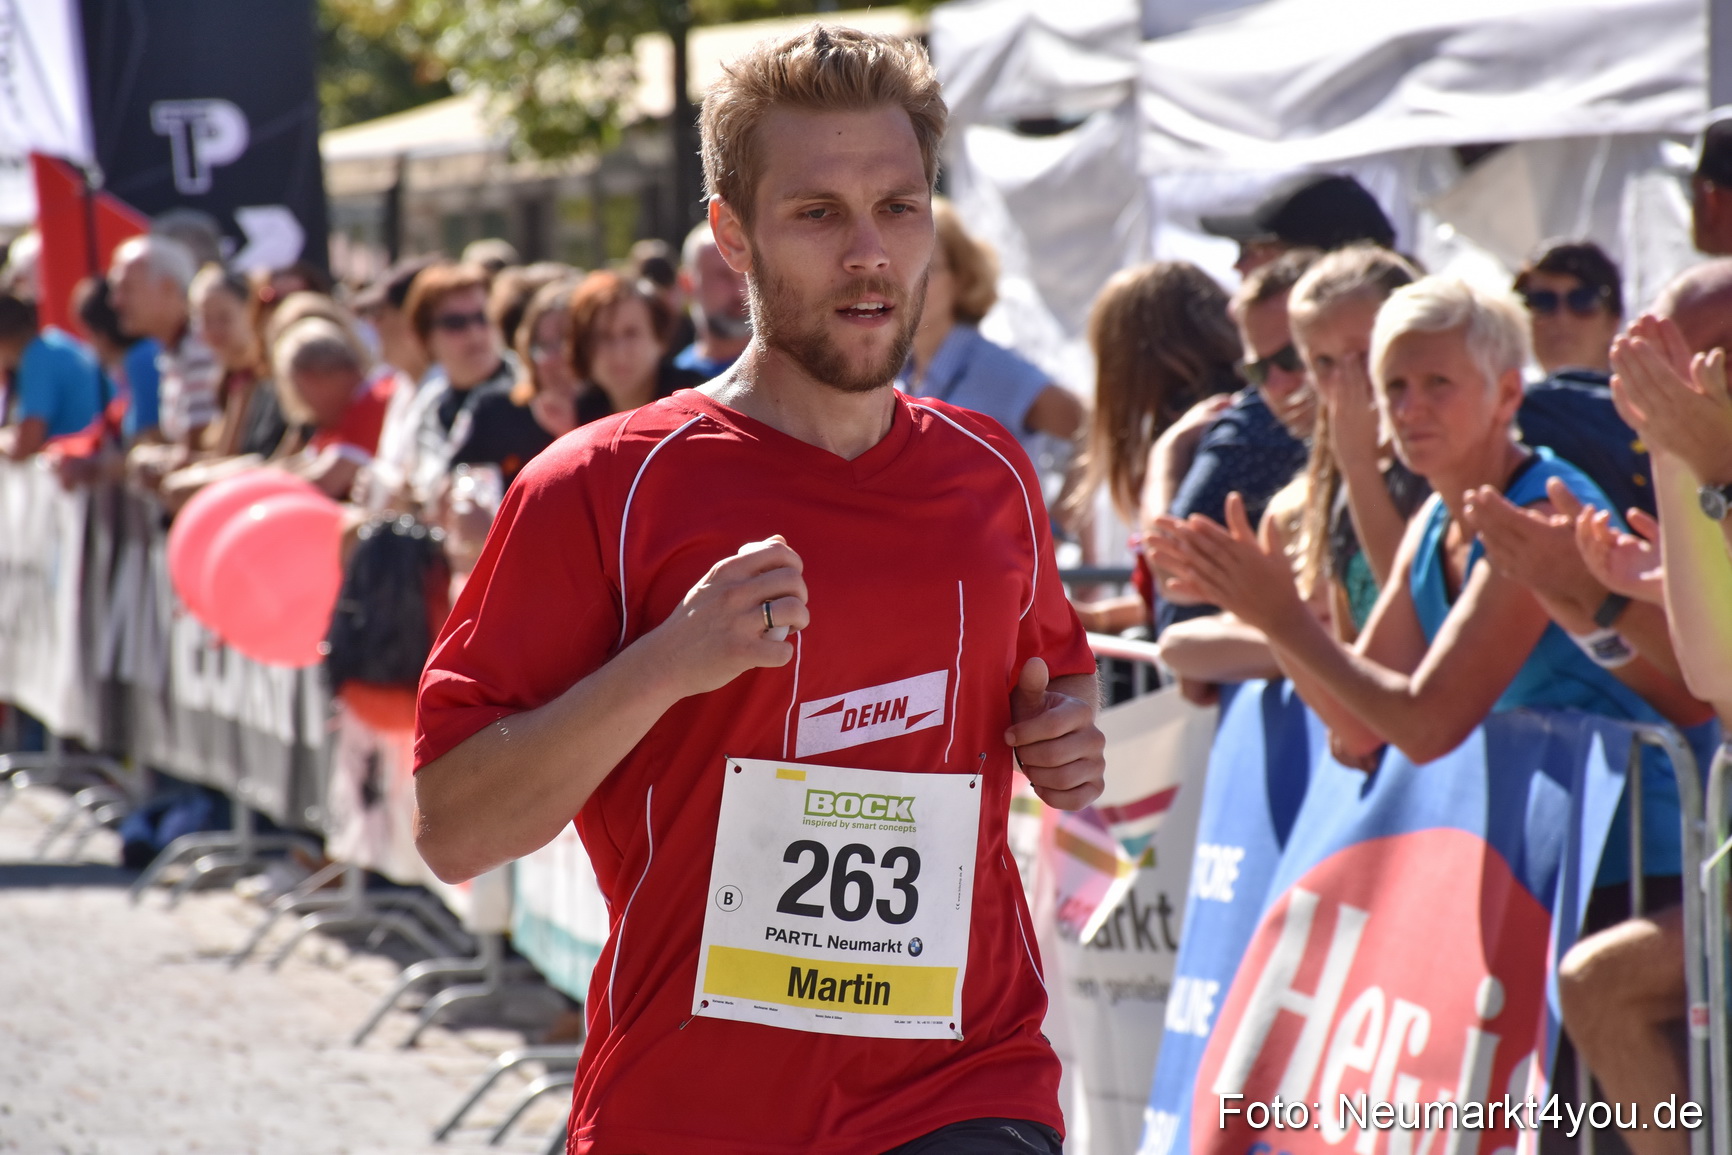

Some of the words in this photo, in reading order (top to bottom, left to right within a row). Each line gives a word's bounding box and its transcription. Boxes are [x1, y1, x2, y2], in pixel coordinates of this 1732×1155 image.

[840, 696, 909, 733] DEHN
[804, 789, 916, 823] BOCK
[802, 817, 838, 828] inspired
[839, 820, 850, 830] by
[852, 821, 877, 830] smart
[878, 824, 917, 834] concepts
[723, 891, 734, 906] B
[776, 840, 922, 925] 263
[765, 926, 823, 948] PARTL
[827, 935, 903, 953] Neumarkt
[787, 966, 891, 1006] Martin
